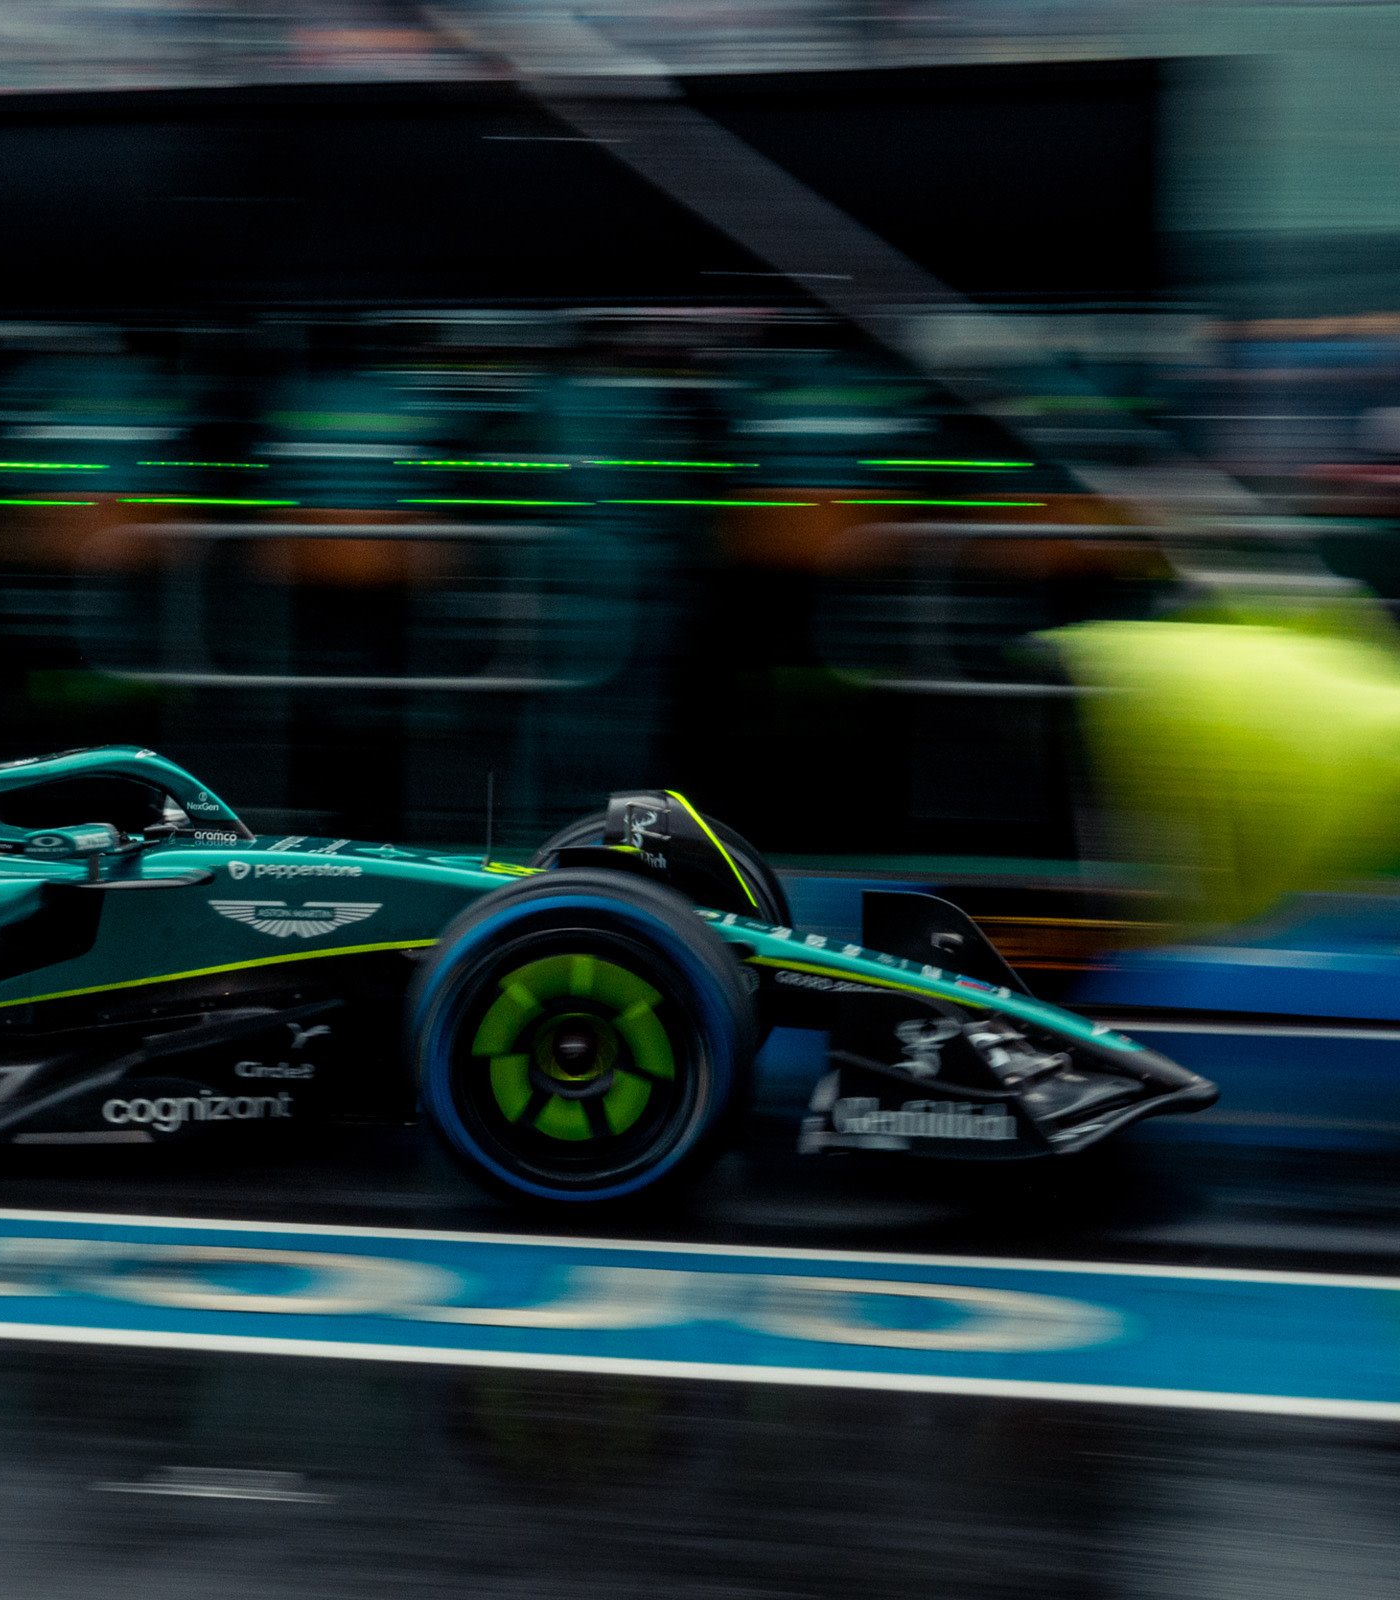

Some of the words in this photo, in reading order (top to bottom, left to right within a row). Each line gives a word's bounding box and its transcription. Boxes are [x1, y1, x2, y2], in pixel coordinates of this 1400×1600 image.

[186, 801, 219, 811] NexGen
[194, 831, 237, 841] aramco
[255, 863, 363, 879] pepperstone
[102, 1089, 293, 1131] cognizant
